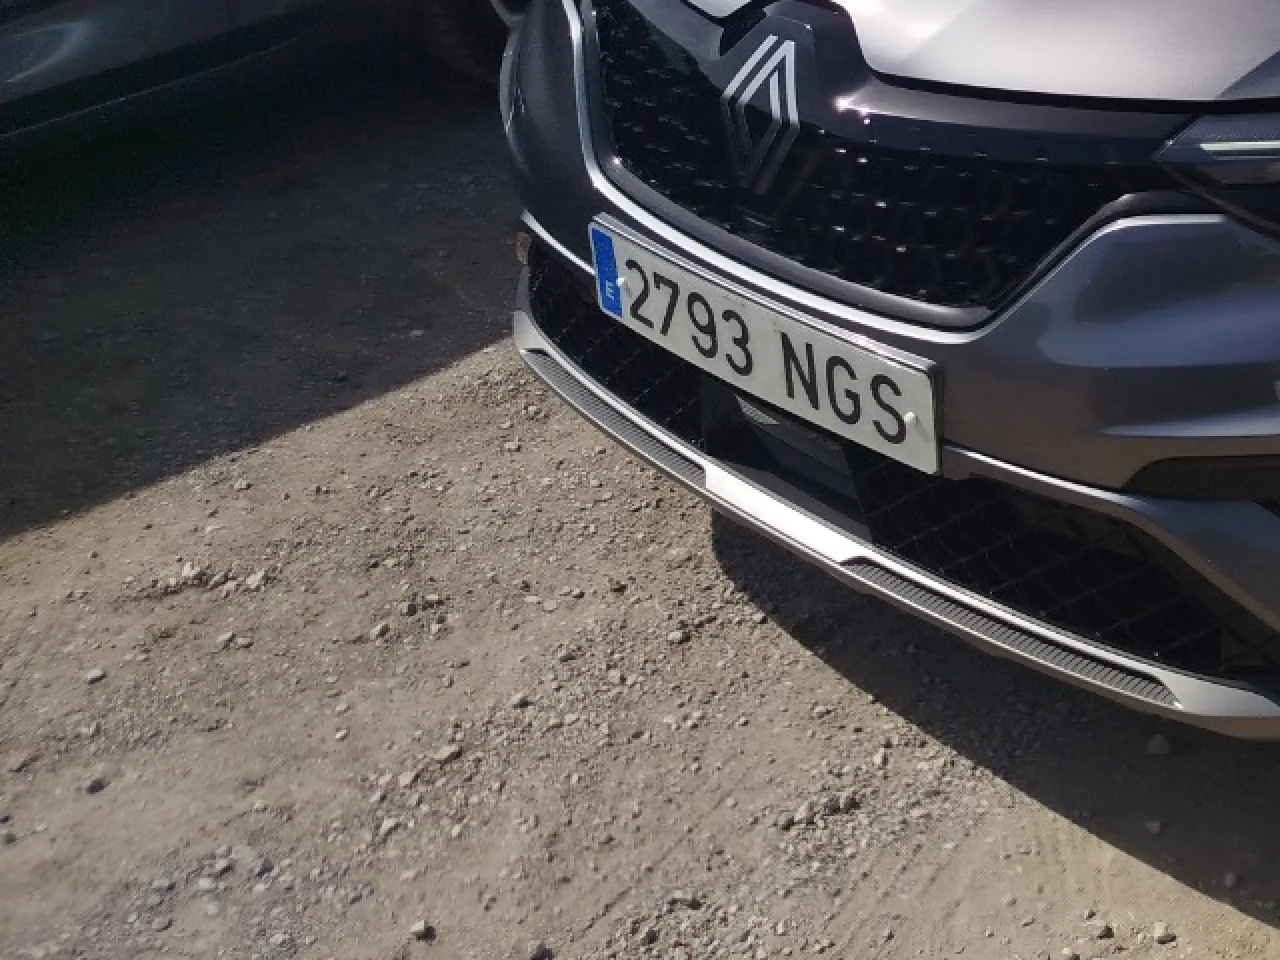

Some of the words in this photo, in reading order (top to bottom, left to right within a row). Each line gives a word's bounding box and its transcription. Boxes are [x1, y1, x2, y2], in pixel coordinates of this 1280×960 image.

[605, 281, 615, 301] E
[625, 258, 754, 376] 2793
[780, 330, 907, 445] NGS
